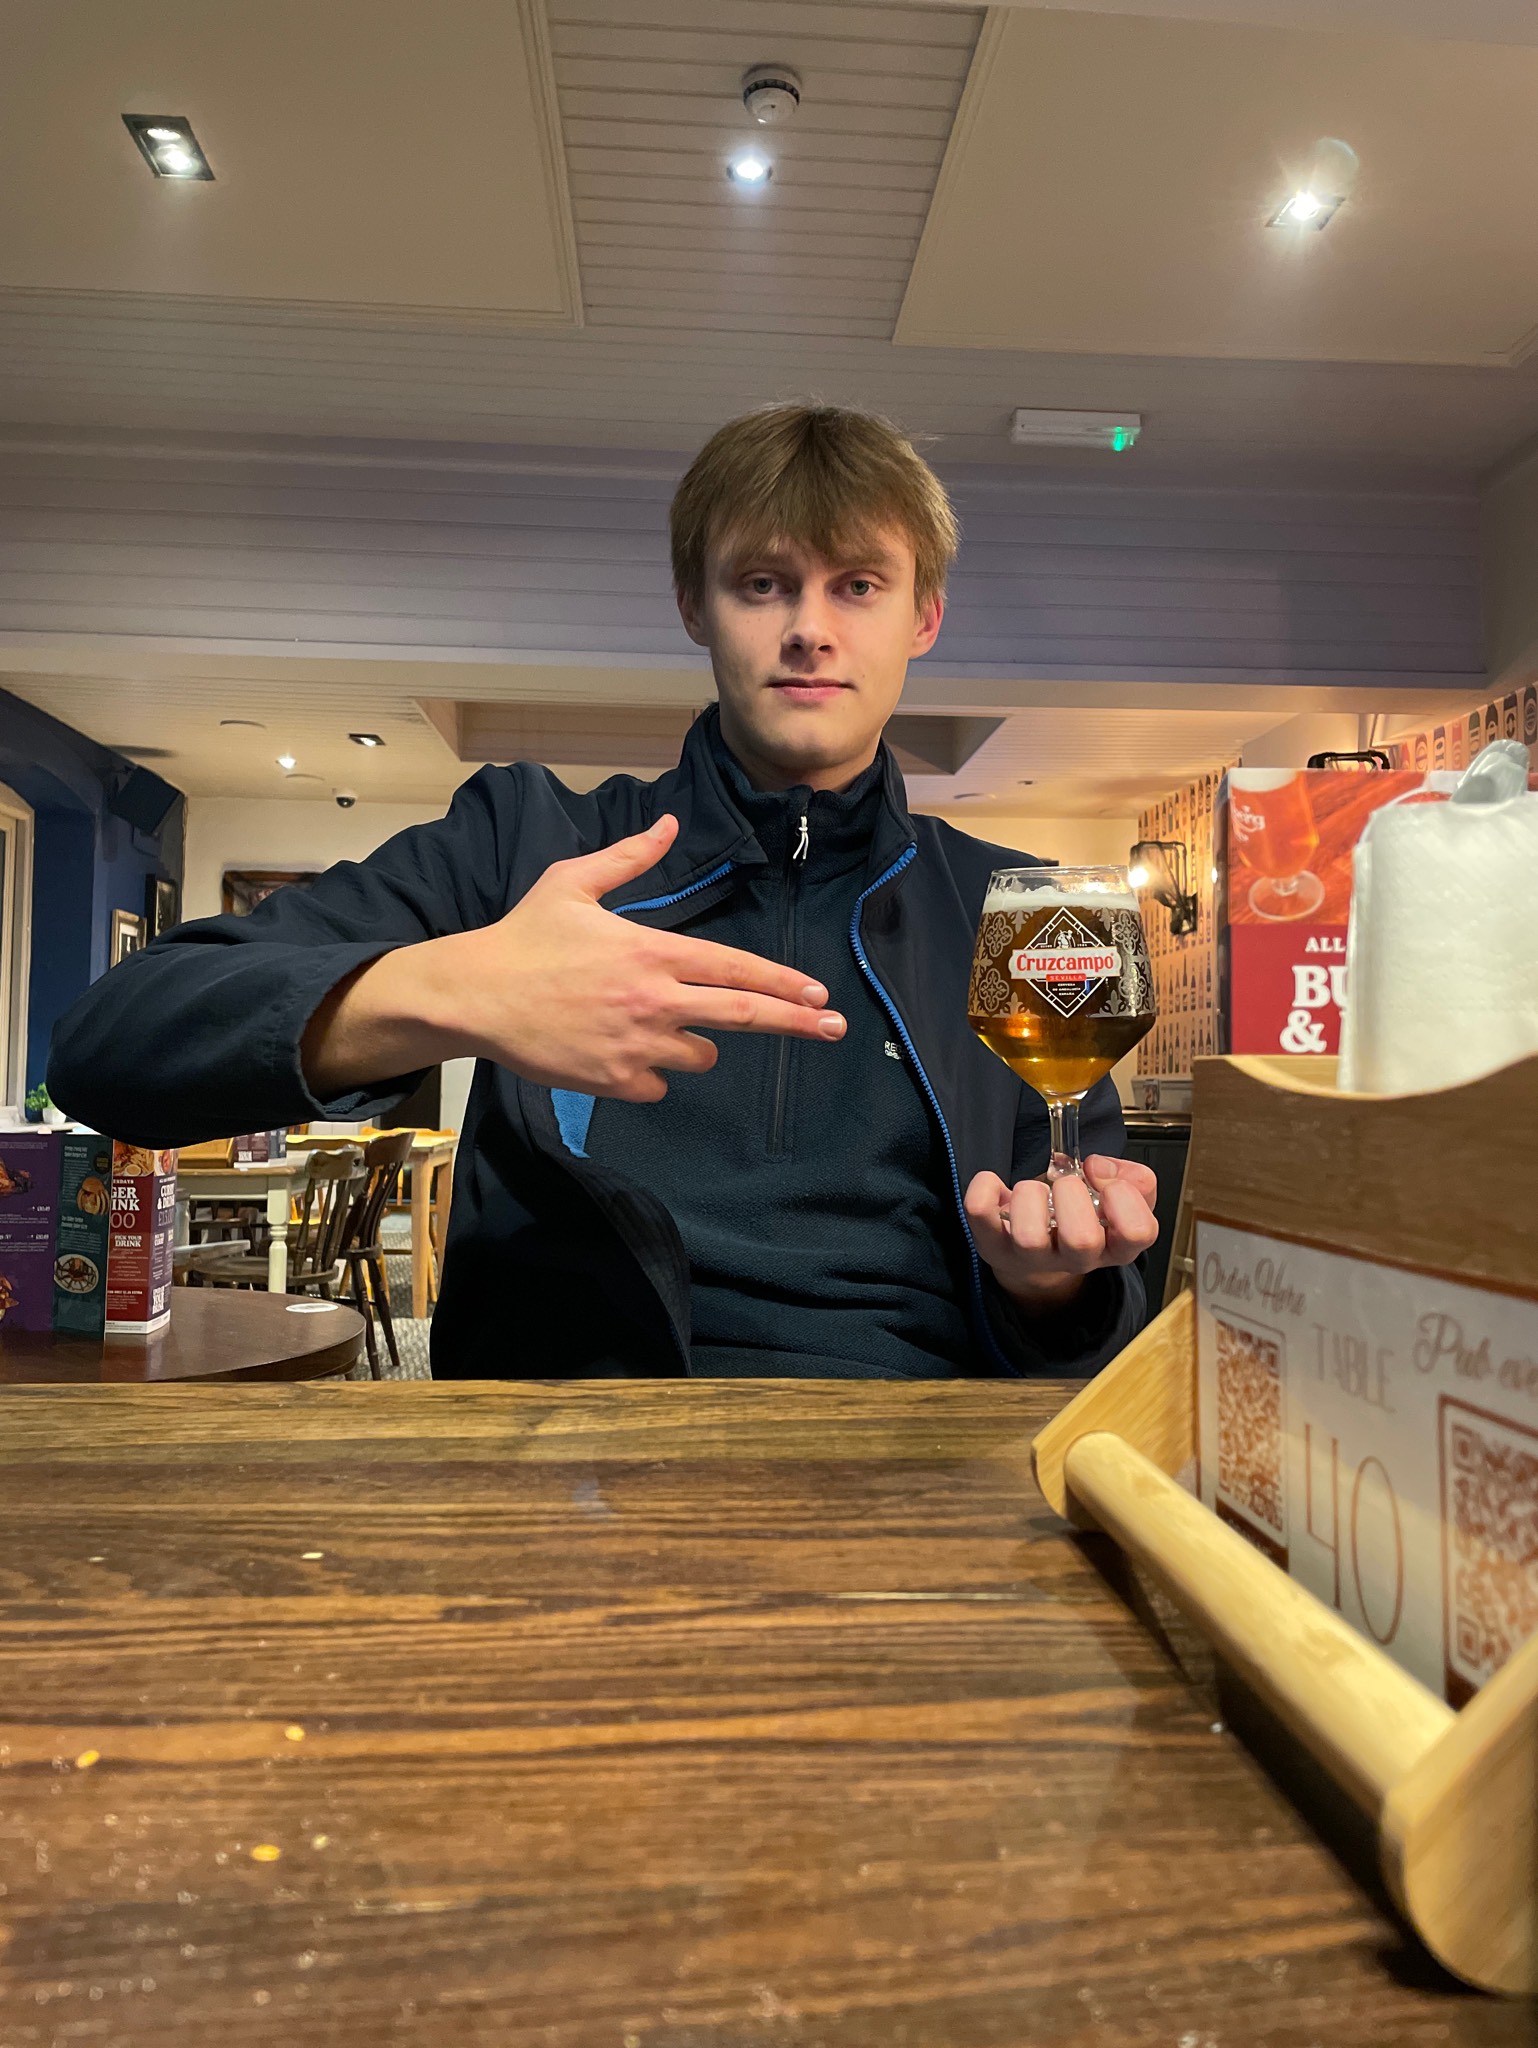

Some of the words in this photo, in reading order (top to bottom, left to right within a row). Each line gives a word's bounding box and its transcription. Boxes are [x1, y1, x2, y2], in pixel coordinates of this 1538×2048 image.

[1016, 953, 1115, 973] Cruzcampo
[1304, 936, 1346, 953] ALL
[1279, 1008, 1328, 1054] &
[115, 1240, 141, 1248] DRINK
[1313, 1321, 1398, 1415] TABLE
[1412, 1311, 1493, 1380] Pub
[1304, 1423, 1404, 1647] 40
